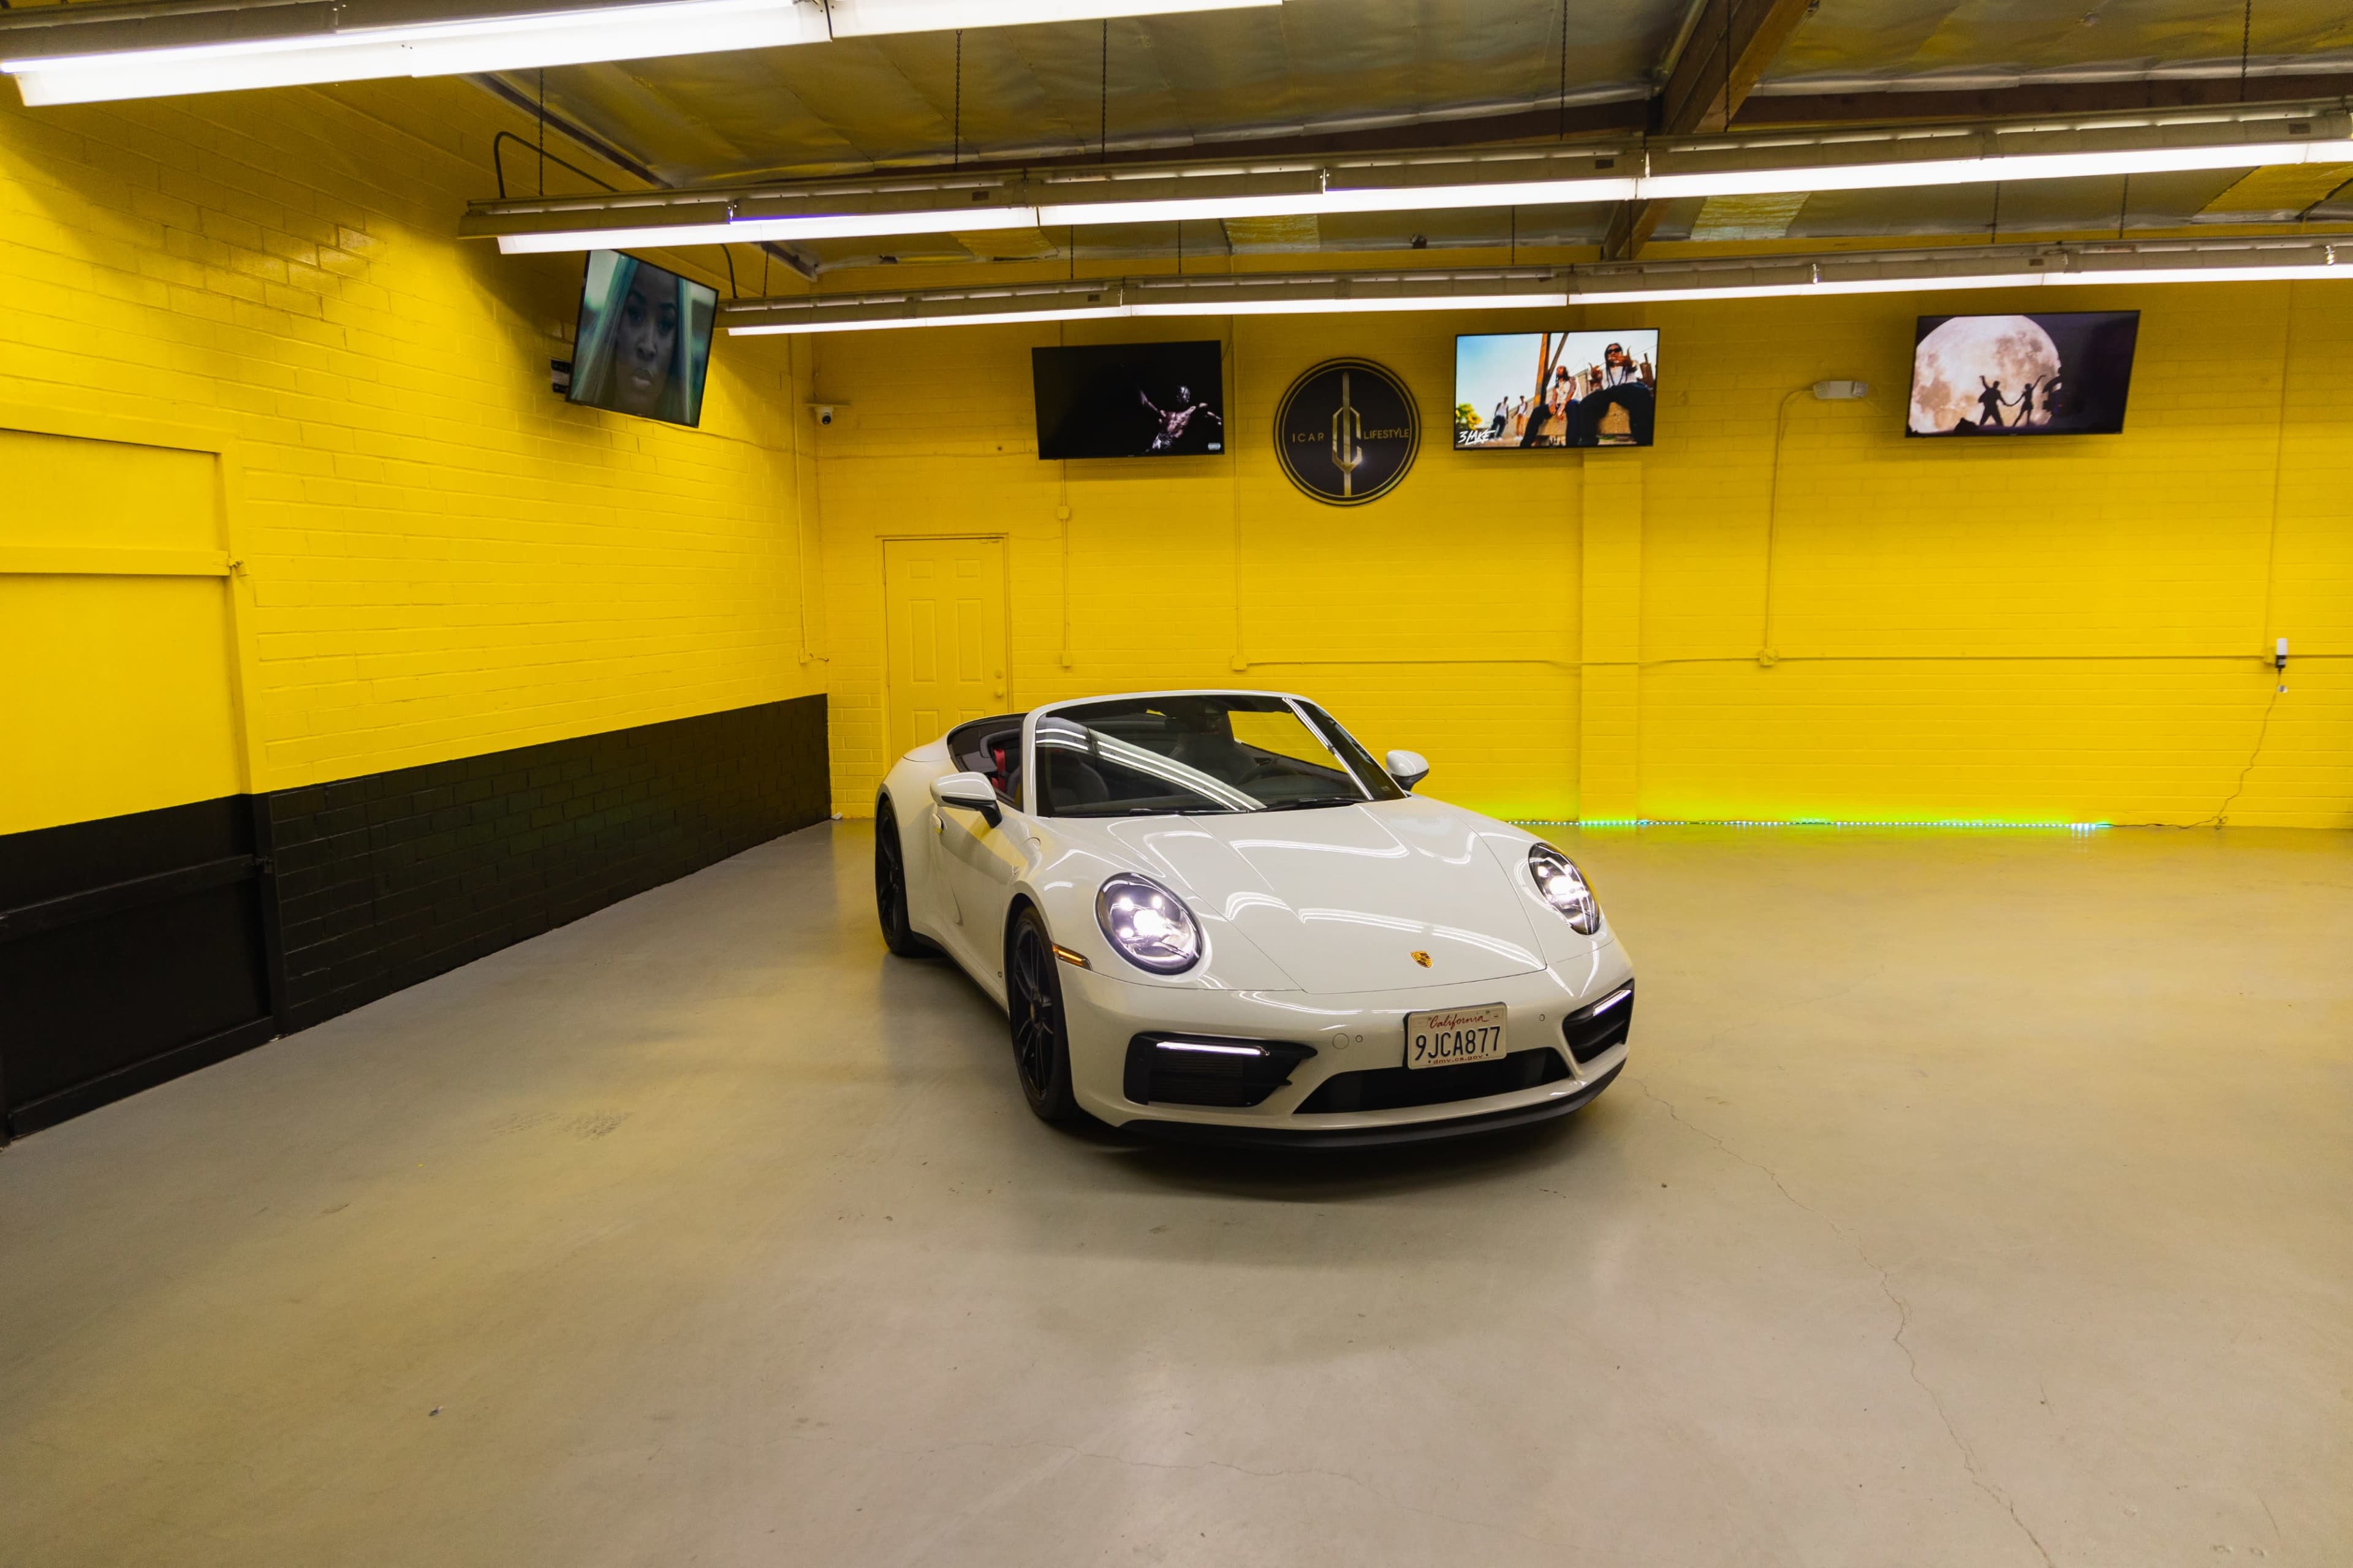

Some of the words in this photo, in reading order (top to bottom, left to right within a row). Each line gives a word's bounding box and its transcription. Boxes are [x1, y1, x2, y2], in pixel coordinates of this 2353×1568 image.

[1363, 428, 1409, 440] LIFESTYLE
[1430, 1014, 1490, 1030] California
[1415, 1026, 1500, 1061] 9JCA877
[1433, 1055, 1483, 1064] dmv.ca.gov
